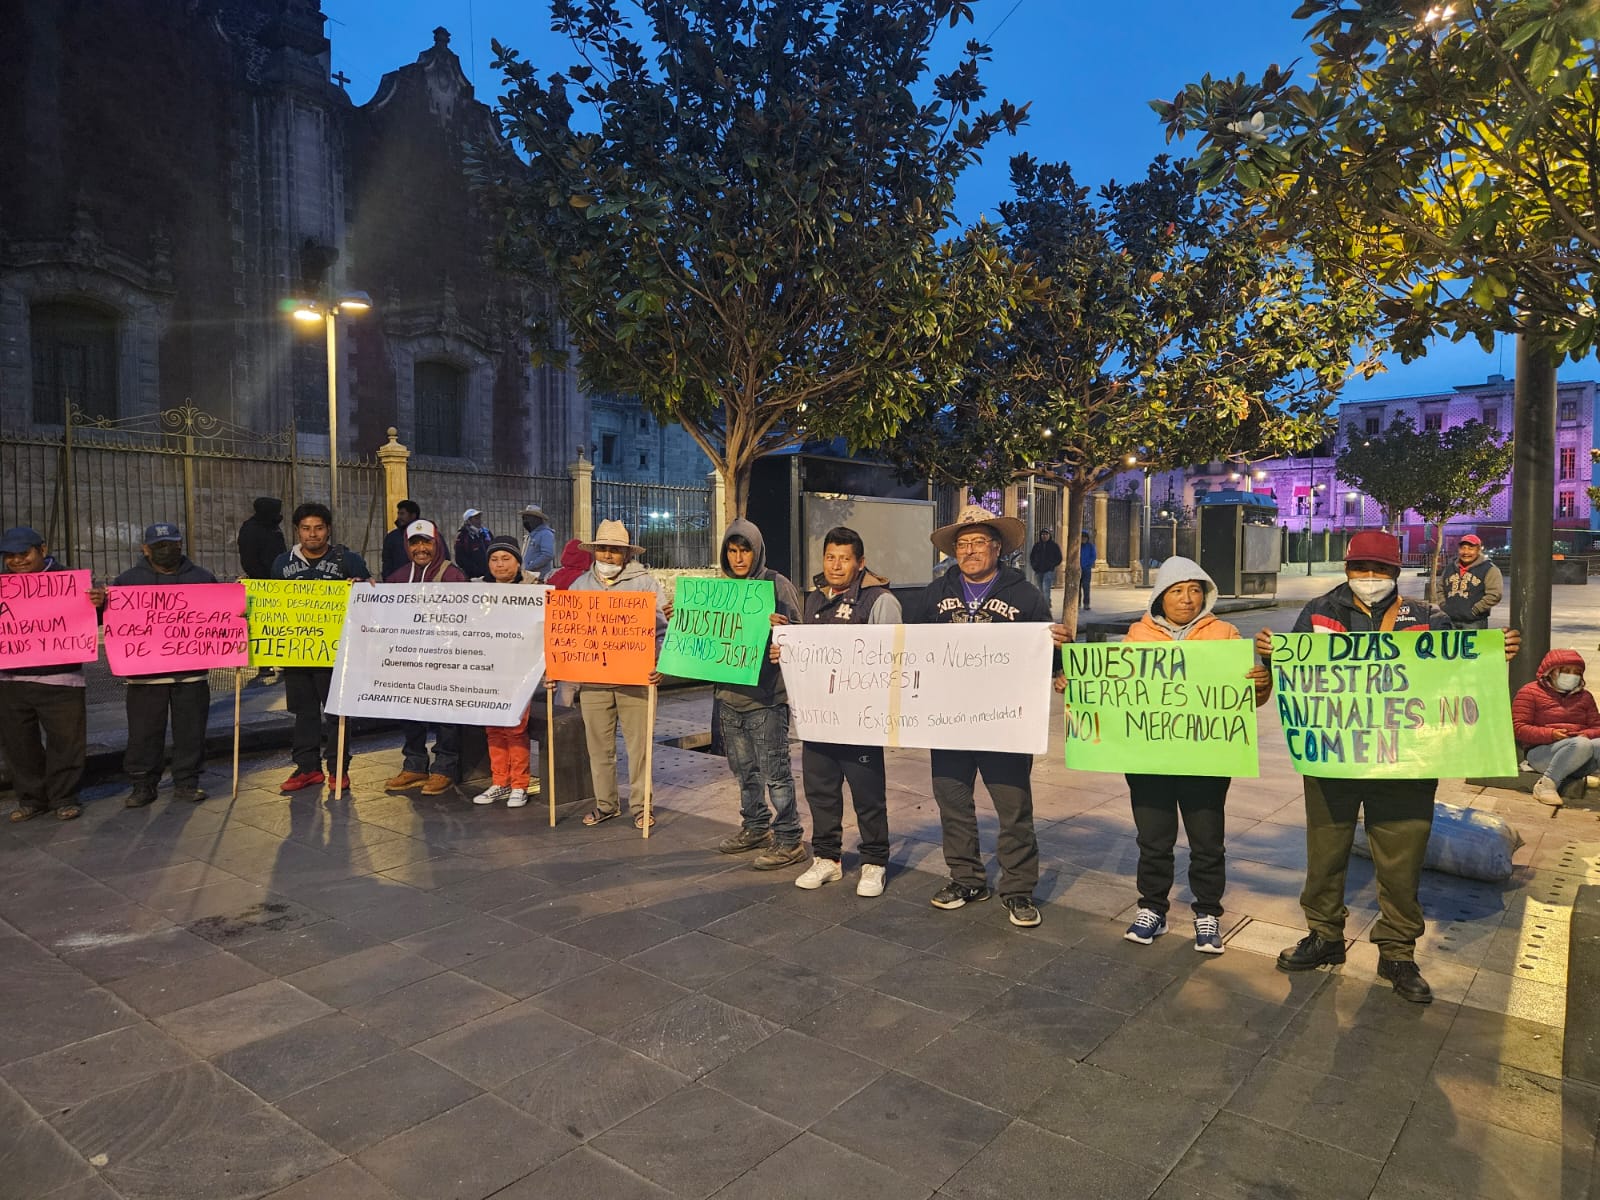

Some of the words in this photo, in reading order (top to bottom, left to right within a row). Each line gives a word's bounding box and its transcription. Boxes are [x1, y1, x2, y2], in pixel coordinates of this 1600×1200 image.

[108, 589, 189, 612] EXIGIMOS
[396, 594, 470, 605] DESPLAZADOS
[471, 594, 498, 605] CON
[501, 595, 543, 607] ARMAS
[588, 596, 601, 610] DE
[742, 582, 764, 615] ES
[145, 609, 232, 626] REGRESAR
[254, 611, 289, 624] FORMA
[413, 613, 428, 623] DE
[429, 613, 467, 624] FUEGO!
[552, 609, 579, 621] EDAD
[586, 611, 592, 623] Y
[104, 623, 114, 638] A
[117, 623, 153, 637] CASA
[164, 625, 191, 639] CON
[261, 624, 325, 637] NUESTRAS
[400, 627, 435, 636] nuestras
[462, 630, 494, 639] carros,
[495, 631, 525, 640] motos,
[551, 622, 598, 636] REGRESAR
[601, 625, 608, 636] A
[38, 637, 46, 652] Y
[124, 641, 152, 659] DE
[160, 639, 248, 657] SEGURIDAD
[395, 645, 417, 653] todos
[418, 647, 453, 655] nuestros
[583, 639, 599, 650] CON
[603, 641, 647, 652] SEGURIDAD
[1272, 634, 1313, 662] 30
[1328, 632, 1400, 662] DIAS
[1415, 631, 1480, 660] QUE
[551, 651, 557, 663] Y
[852, 637, 917, 666] Retorno
[926, 651, 935, 664] a
[942, 640, 1011, 668] Nuestros
[424, 662, 461, 670] regresar
[469, 663, 494, 672] casa!
[1069, 646, 1188, 681] NUESTRA
[373, 679, 416, 690] Presidenta
[417, 682, 448, 692] Claudia
[1274, 663, 1410, 694] NUESTROS
[1067, 677, 1150, 708] TIERRA
[1162, 682, 1188, 707] ES
[1196, 685, 1254, 713] VIDA
[413, 697, 454, 707] NUESTRA
[455, 699, 512, 711] SEGURIDAD!
[1278, 694, 1426, 730] ANIMALES
[1439, 695, 1480, 726] NO
[1125, 710, 1250, 746] MERCANCIA
[1286, 728, 1400, 764] COMEN
